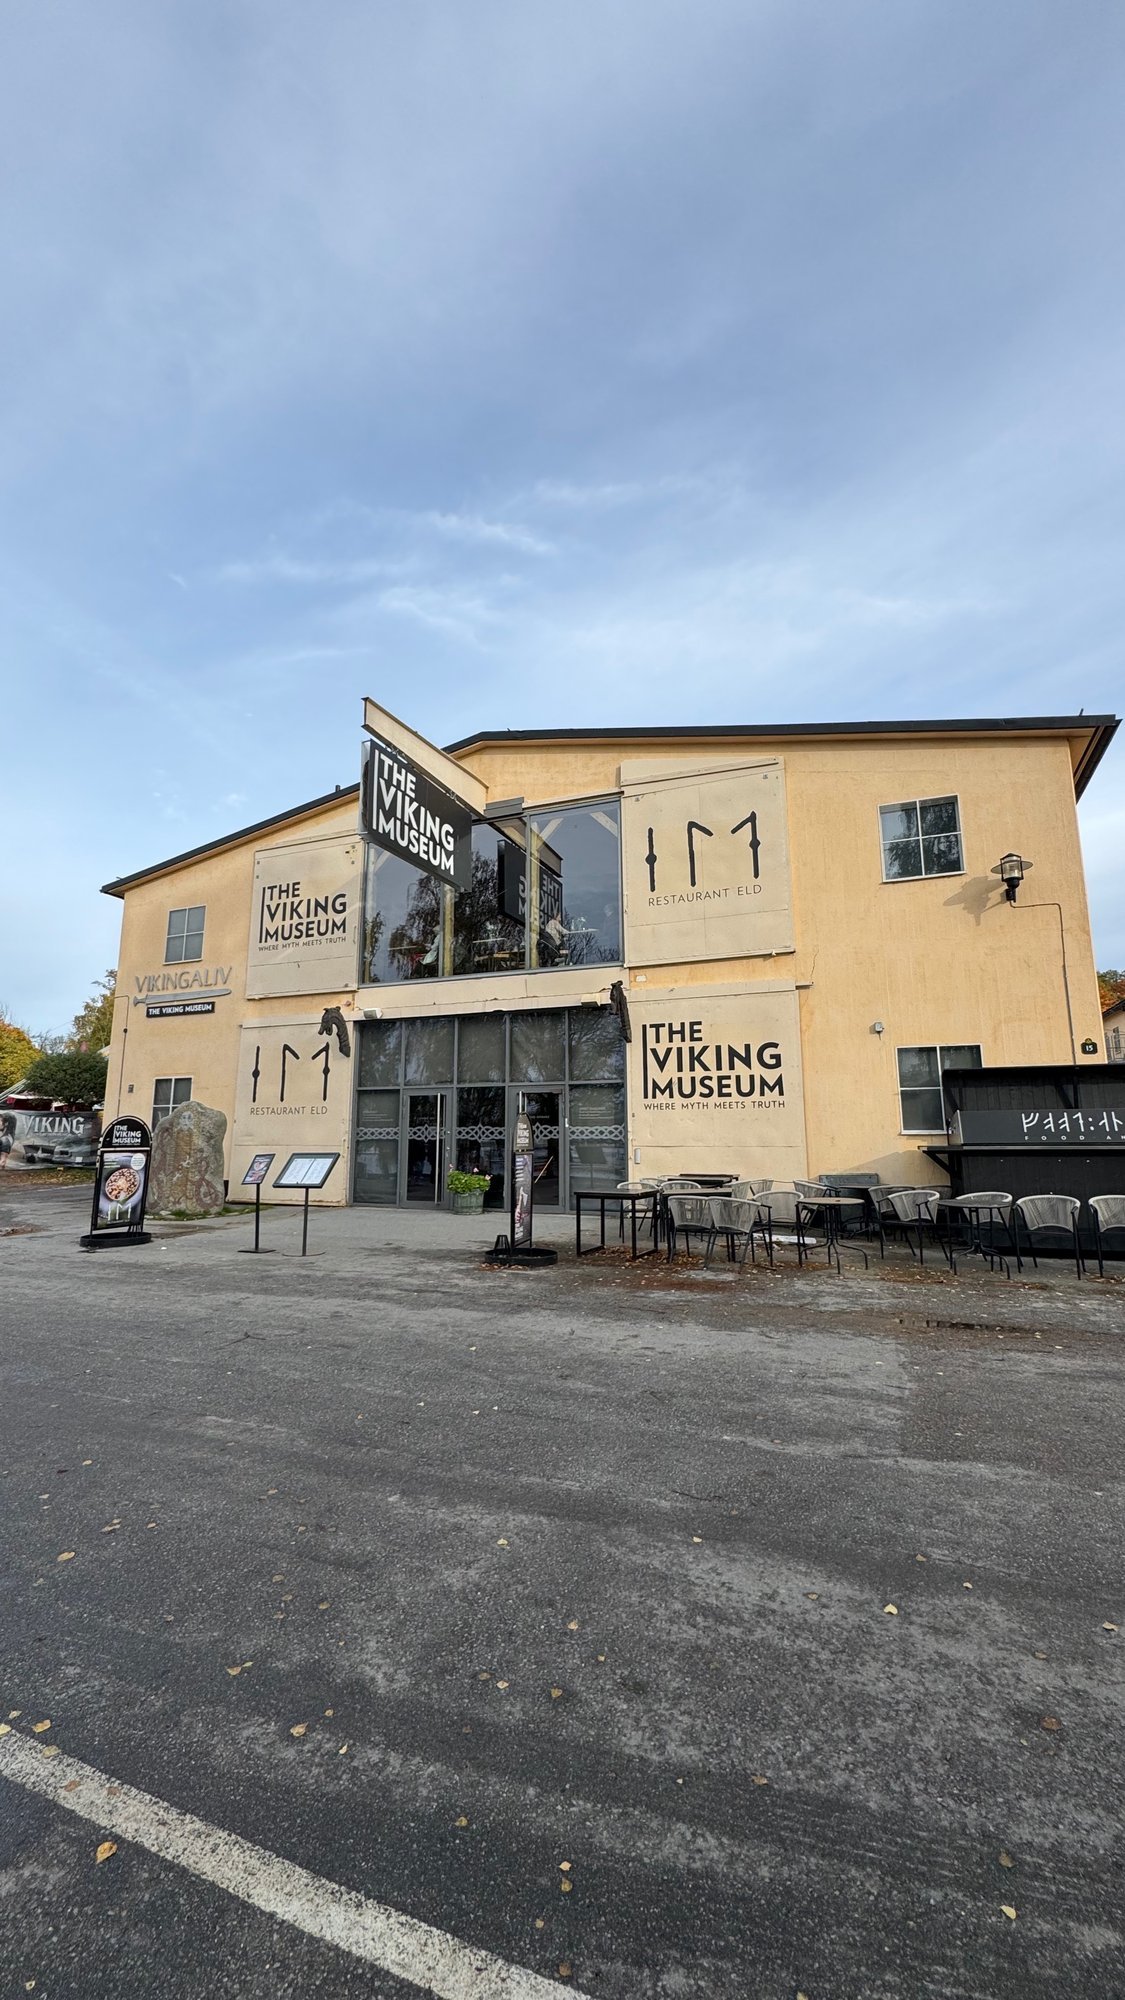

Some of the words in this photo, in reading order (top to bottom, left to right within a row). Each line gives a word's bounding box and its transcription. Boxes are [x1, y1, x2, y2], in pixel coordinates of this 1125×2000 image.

[380, 753, 417, 798] THE
[379, 777, 454, 851] VIKING
[378, 809, 455, 875] MUSEUM
[267, 881, 301, 901] THE
[648, 887, 730, 907] RESTAURANT
[737, 884, 762, 896] ELD
[266, 893, 347, 923] VIKING
[264, 917, 347, 943] MUSEUM
[258, 944, 279, 952] WHERE
[281, 941, 300, 949] MYTH
[302, 939, 322, 947] MEETS
[325, 936, 346, 944] TRUTH
[134, 966, 233, 993] VIKINGALIV
[148, 1007, 161, 1015] THE
[162, 1005, 184, 1014] VIKING
[185, 1003, 212, 1012] MUSEUM
[649, 1021, 703, 1043] THE
[650, 1042, 782, 1073] VIKING
[652, 1073, 785, 1099] MUSEUM
[250, 1106, 306, 1115] RESTAURANT
[310, 1106, 328, 1115] ELD
[643, 1102, 676, 1110] WHERE
[681, 1102, 709, 1110] MYTH
[714, 1101, 746, 1109] MEETS
[751, 1100, 785, 1109] TRUTH
[22, 1115, 85, 1135] VIKING
